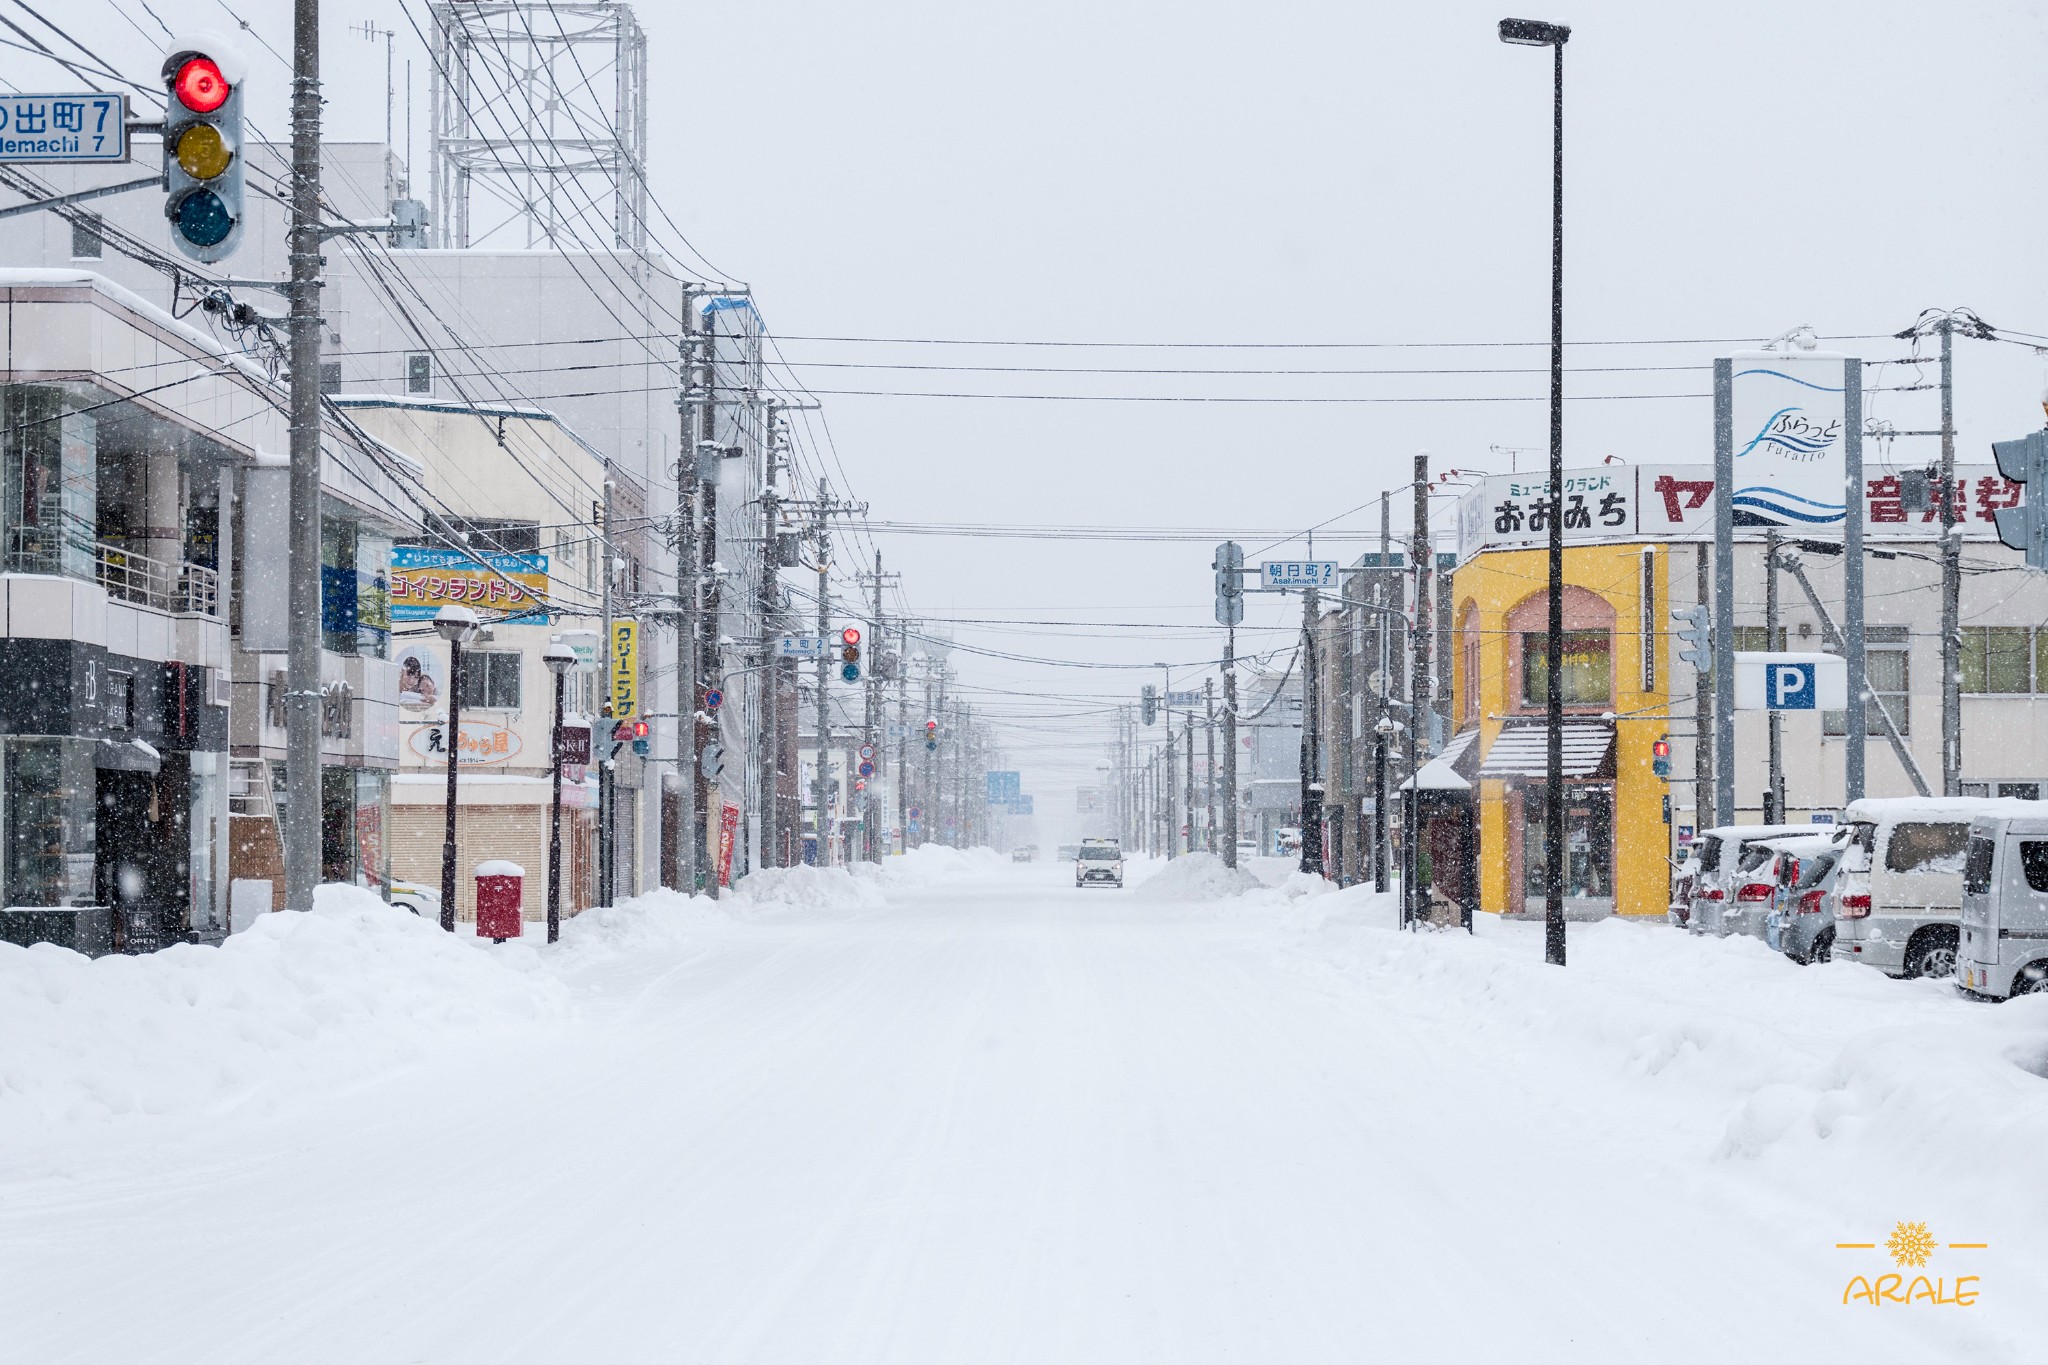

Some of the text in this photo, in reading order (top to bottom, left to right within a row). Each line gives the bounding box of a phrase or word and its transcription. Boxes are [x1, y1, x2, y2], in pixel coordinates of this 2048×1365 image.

[92, 136, 105, 152] 7
[1772, 415, 1841, 438] ふらっと
[1766, 442, 1826, 462] Furatto
[1494, 492, 1627, 533] おおみち
[1269, 564, 1332, 577] 朝日町2
[1272, 577, 1328, 585] Asahimachi 2
[391, 575, 544, 603] コインランドリー
[617, 627, 634, 716] クリーニング
[1776, 667, 1806, 706] P
